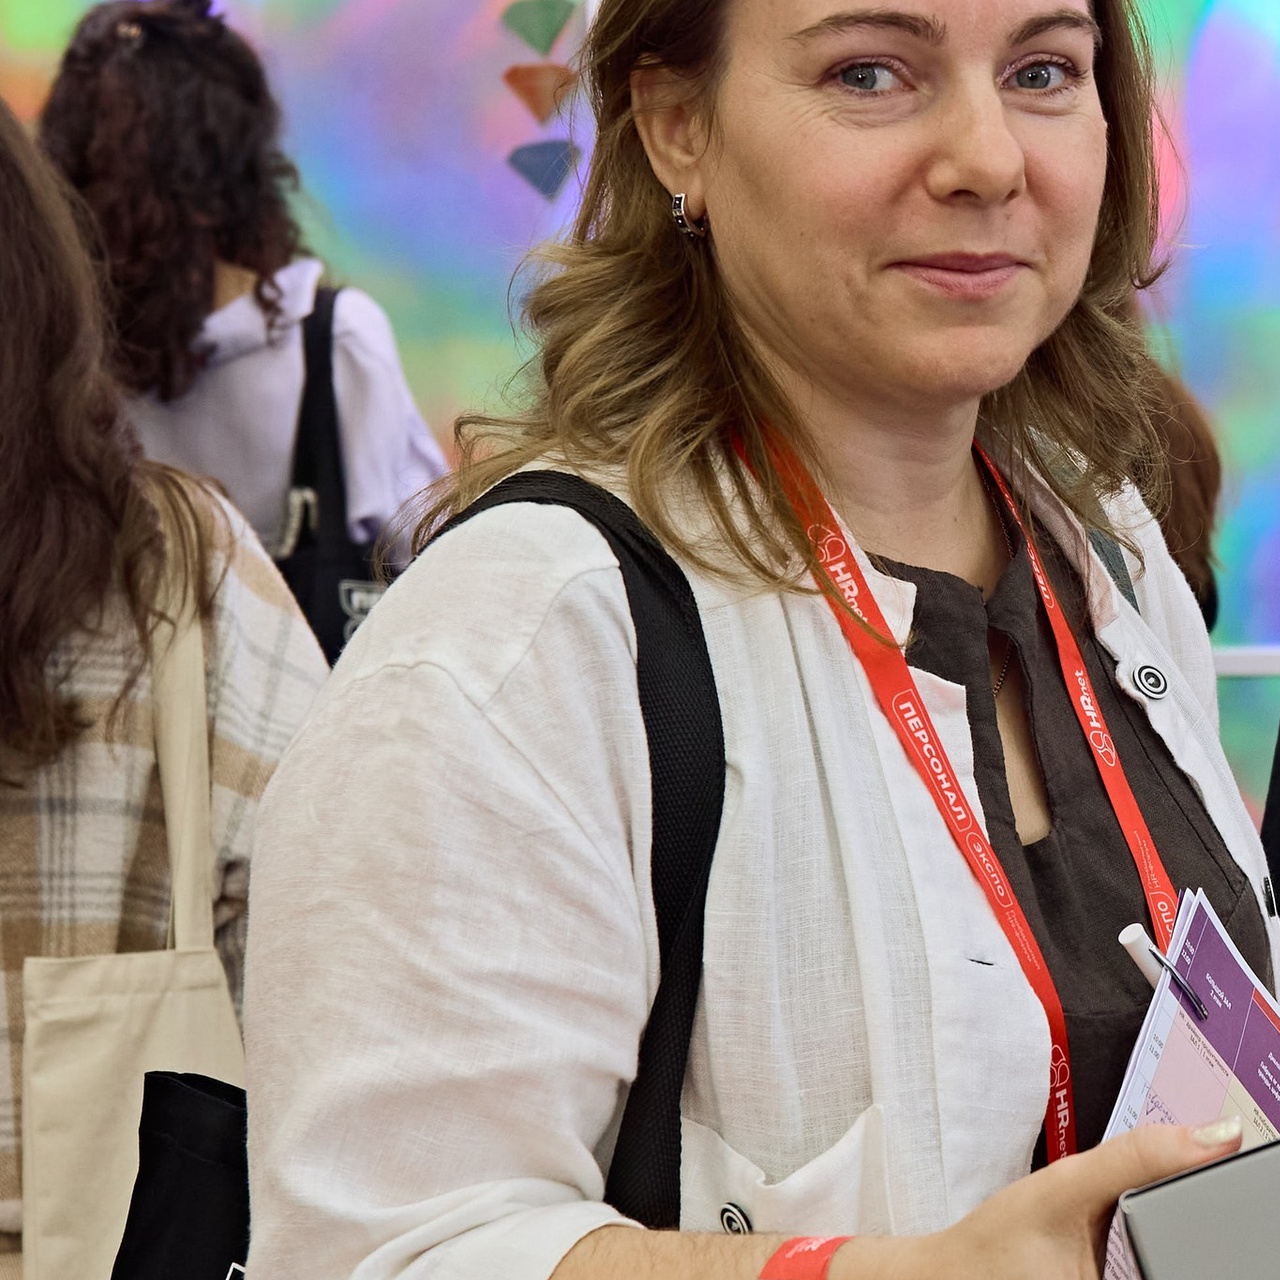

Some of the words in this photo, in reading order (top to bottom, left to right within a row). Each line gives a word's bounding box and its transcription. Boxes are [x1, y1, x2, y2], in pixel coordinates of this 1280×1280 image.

[1075, 670, 1101, 728] HRnet
[899, 701, 967, 821] ПЕРСОНАЛ
[973, 842, 1004, 896] ЭКСПО
[1056, 1089, 1069, 1159] HRnet
